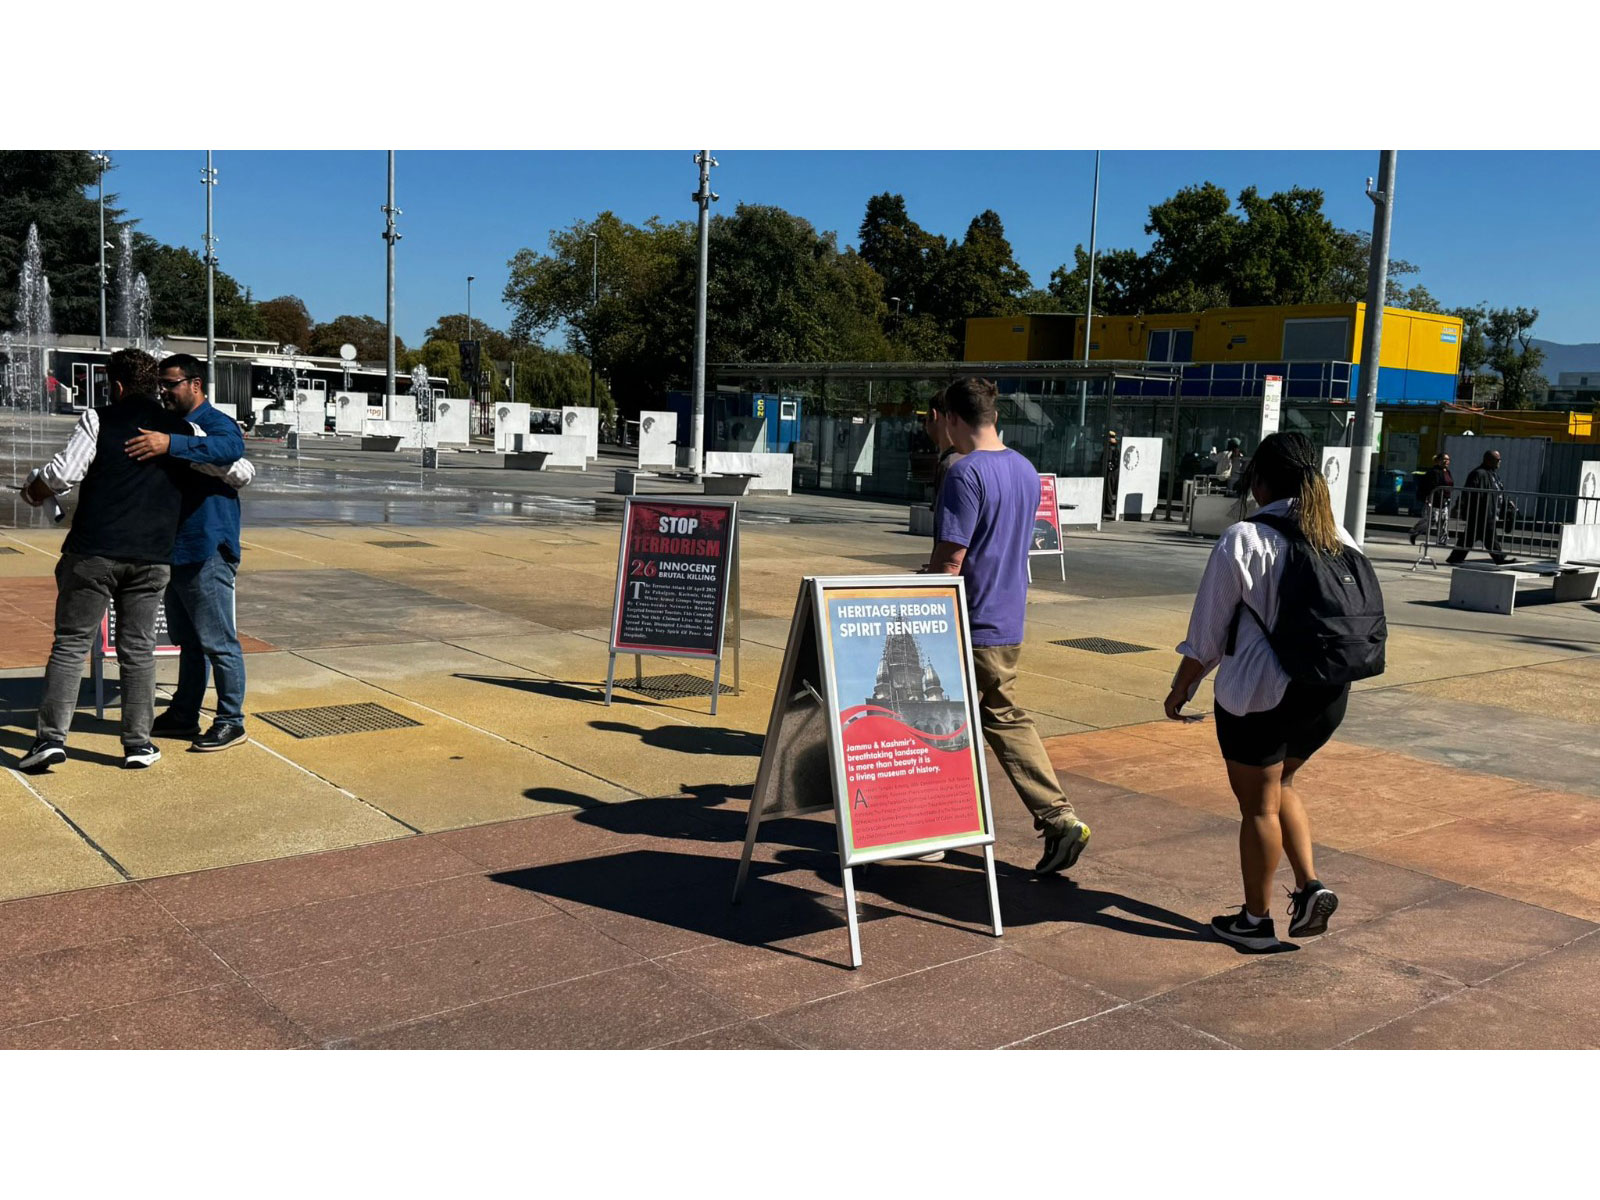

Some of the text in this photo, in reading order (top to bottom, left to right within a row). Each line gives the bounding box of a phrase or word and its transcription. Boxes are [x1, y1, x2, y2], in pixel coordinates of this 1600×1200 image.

[659, 516, 698, 534] STOP
[633, 536, 720, 556] TERRORISM
[630, 559, 657, 578] 26
[659, 561, 716, 574] INNOCENT
[658, 571, 716, 582] BRUTAL KILLING
[838, 603, 946, 618] HERITAGE REBORN
[840, 620, 948, 638] SPIRIT RENEWED
[846, 744, 872, 752] Jammu
[880, 738, 916, 748] Kashmir's
[847, 747, 928, 762] breathtaking landscape
[876, 760, 893, 768] than
[894, 757, 917, 766] beauty
[856, 772, 876, 781] living
[877, 770, 906, 778] museum
[908, 766, 914, 775] of
[916, 765, 941, 774] history.
